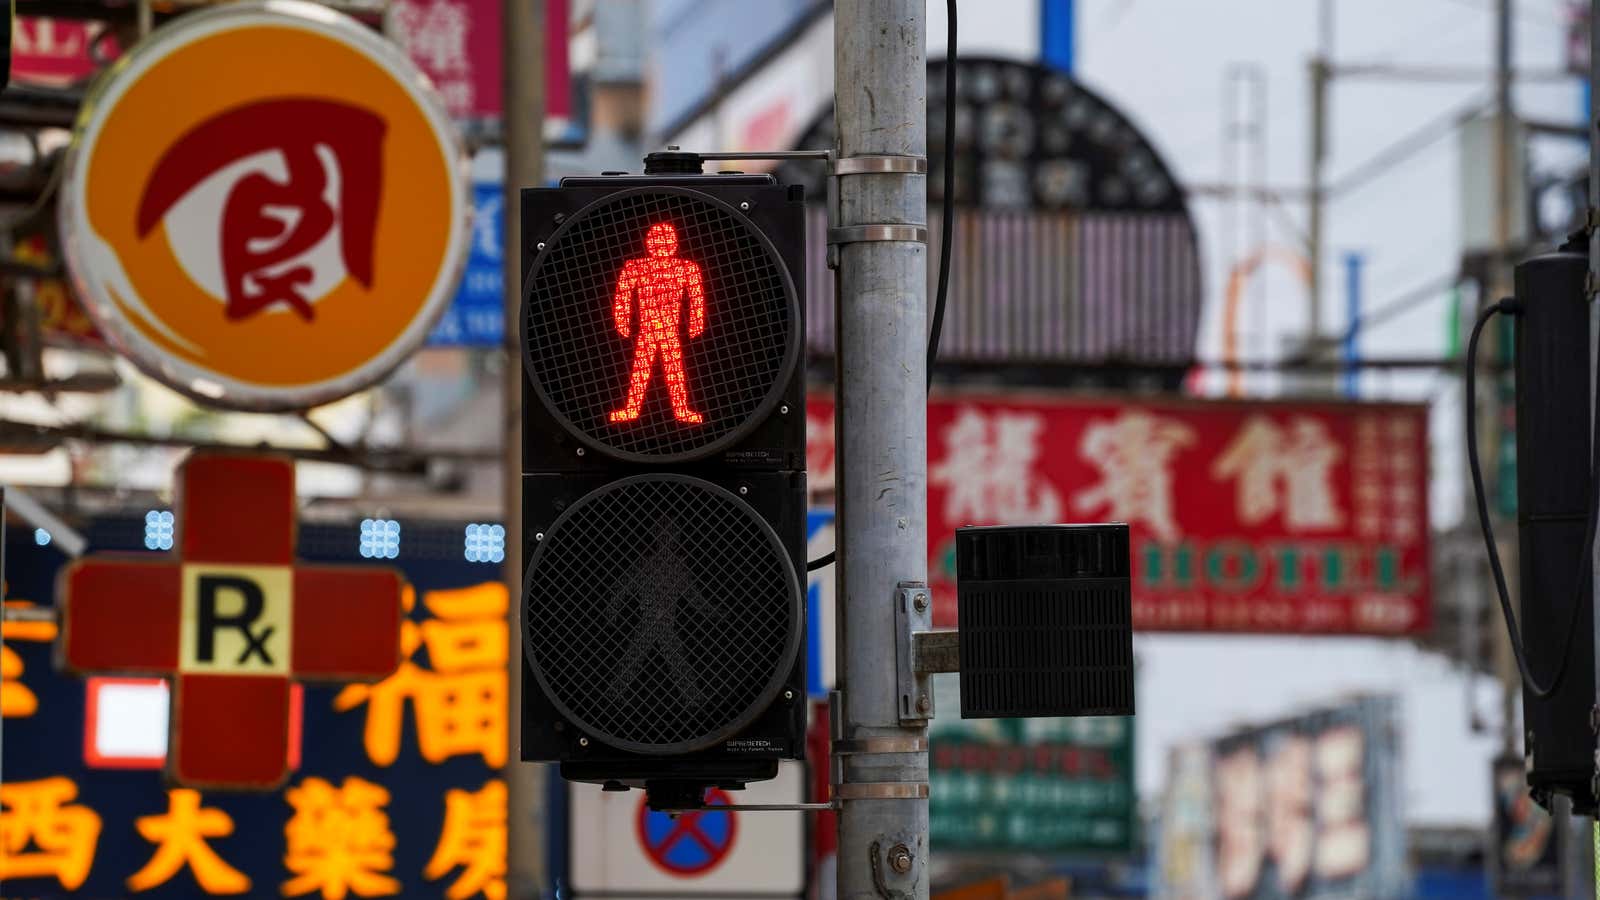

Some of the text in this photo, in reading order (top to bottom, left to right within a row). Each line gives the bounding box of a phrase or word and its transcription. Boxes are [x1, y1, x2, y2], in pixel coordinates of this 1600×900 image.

[806, 408, 1345, 548] 龍賓館
[1140, 538, 1421, 592] HOTEL
[195, 574, 276, 667] Rx
